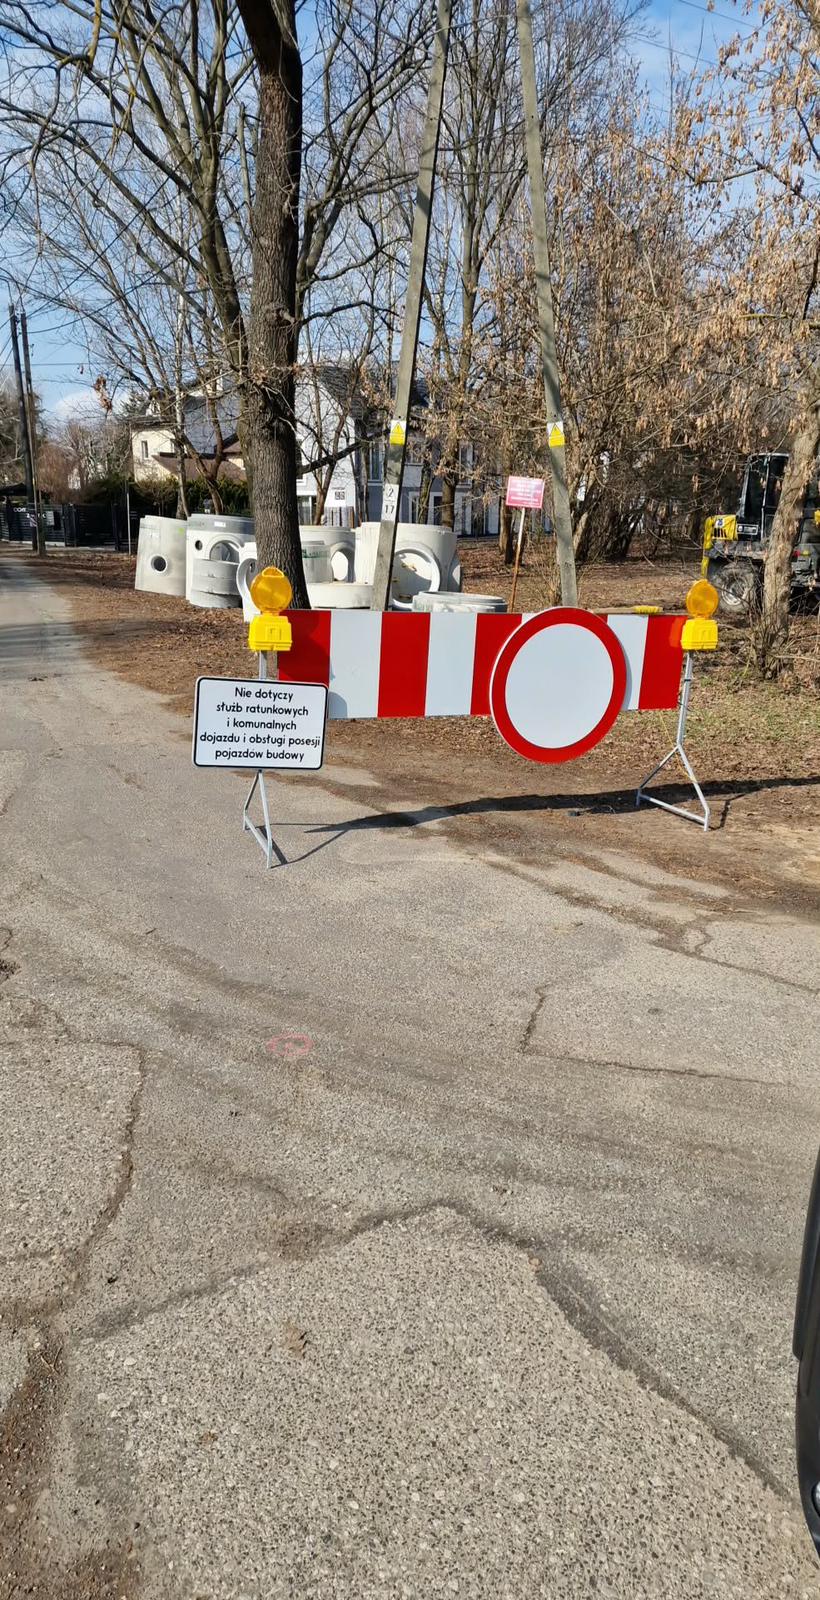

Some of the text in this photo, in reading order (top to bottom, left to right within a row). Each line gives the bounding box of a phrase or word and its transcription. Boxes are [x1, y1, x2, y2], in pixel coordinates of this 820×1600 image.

[235, 687, 293, 703] Nie dotyczy
[216, 702, 309, 718] służb ratunkowych
[226, 717, 297, 732] i komunalnych
[199, 732, 321, 748] dojazdu i obsługi posesji
[215, 747, 305, 762] pojazdów budowy
